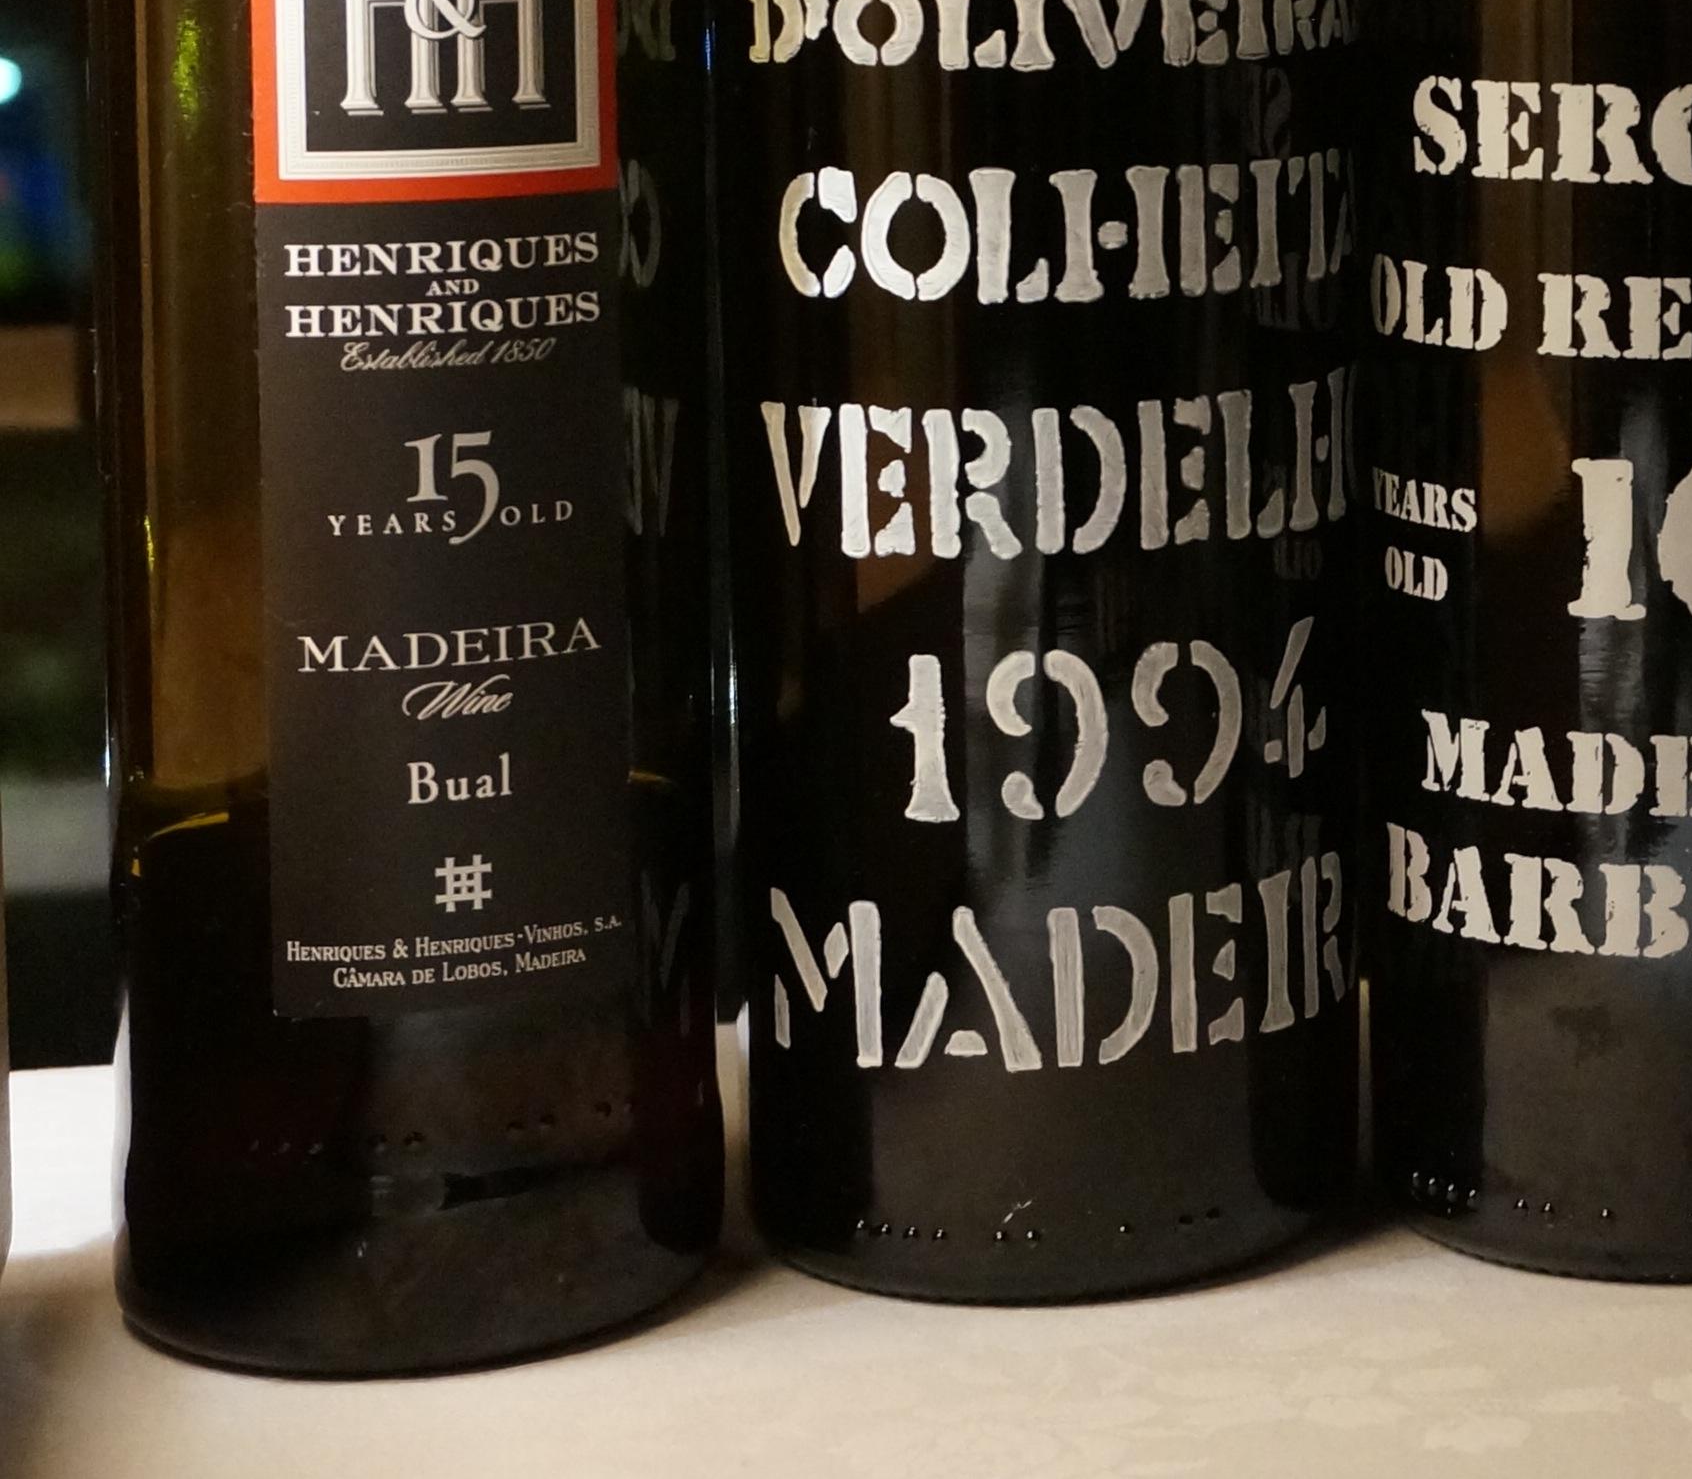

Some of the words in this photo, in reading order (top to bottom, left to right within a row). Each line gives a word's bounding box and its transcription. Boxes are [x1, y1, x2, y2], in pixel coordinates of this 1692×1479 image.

[284, 232, 599, 278] HENRIQUES
[425, 278, 480, 297] AND
[1371, 253, 1508, 352] OLD
[285, 291, 600, 338] HENRIQUES
[340, 339, 493, 372] Established
[490, 337, 557, 364] 1850
[404, 430, 500, 545] 15
[760, 364, 1355, 559] VERDELH
[327, 510, 456, 537] YEARS
[500, 499, 573, 527] OLD
[1371, 466, 1478, 533] YEARS
[1385, 545, 1449, 602] OLD
[297, 617, 601, 673] MADEIRA
[402, 674, 513, 720] Wine
[890, 616, 1326, 822] 1994
[407, 752, 513, 805] Bual
[286, 941, 386, 962] HENRIQUES
[393, 938, 408, 959] &
[594, 915, 622, 933] S.A.
[770, 851, 1355, 1073] MADEIR
[333, 967, 405, 989] CÂMARA
[412, 969, 435, 985] DE
[515, 948, 586, 974] MADEIRA
